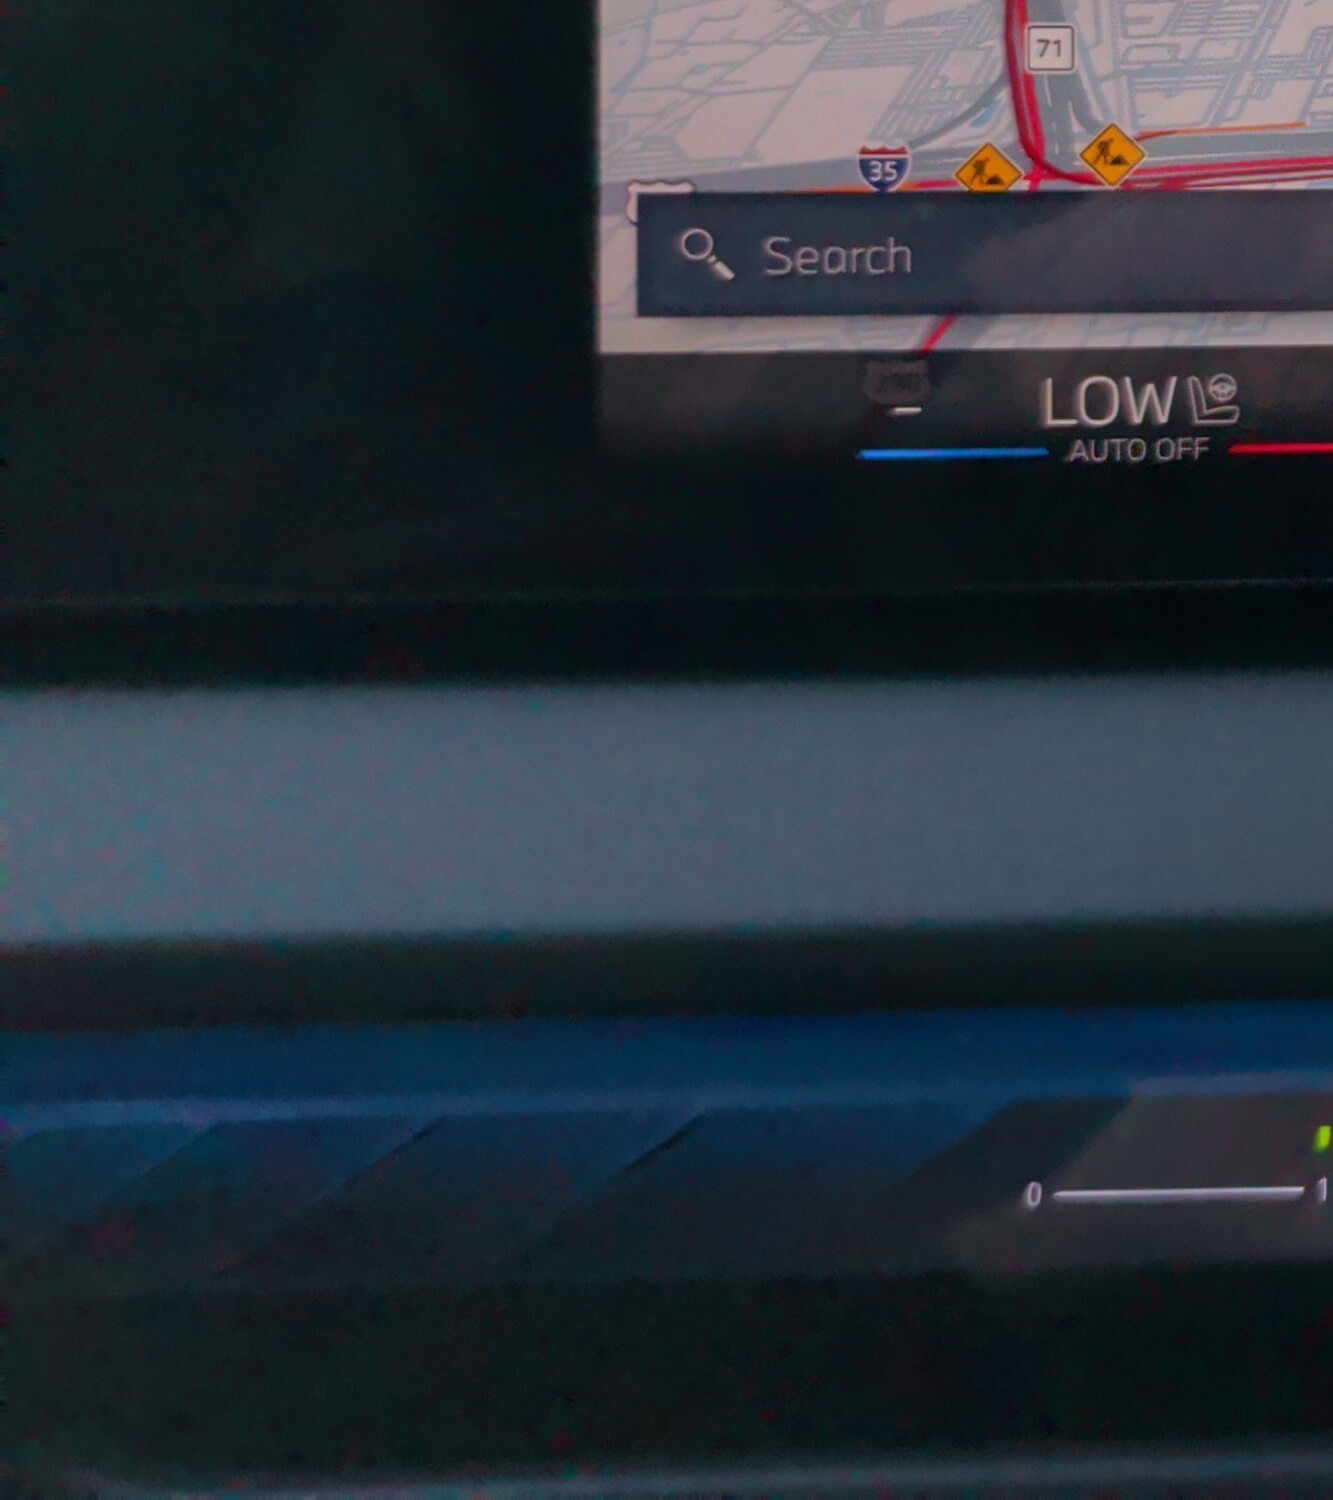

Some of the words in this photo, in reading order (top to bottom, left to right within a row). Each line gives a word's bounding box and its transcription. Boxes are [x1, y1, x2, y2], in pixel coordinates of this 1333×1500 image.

[1036, 37, 1063, 60] 71
[869, 159, 898, 182] 35
[762, 235, 912, 277] Search
[1039, 375, 1179, 428] LOW
[1067, 438, 1147, 464] AUTO
[1154, 436, 1210, 462] OFF
